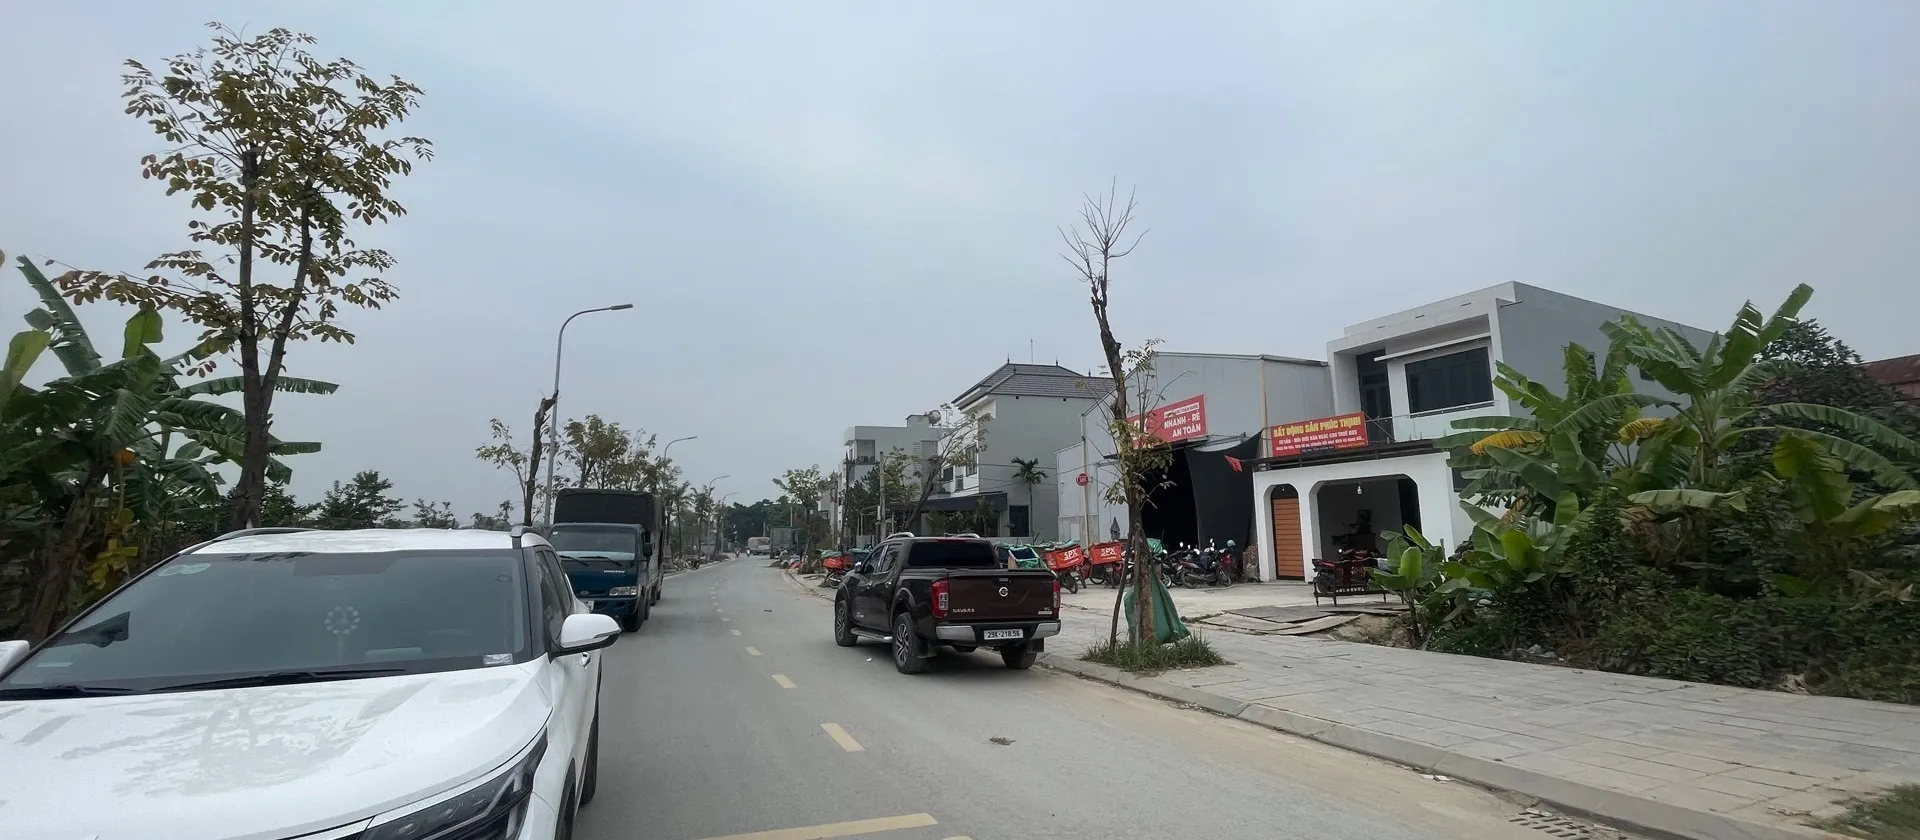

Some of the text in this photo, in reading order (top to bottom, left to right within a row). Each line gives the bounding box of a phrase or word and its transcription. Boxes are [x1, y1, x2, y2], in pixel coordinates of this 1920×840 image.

[1164, 415, 1186, 429] NHANH
[1320, 419, 1338, 430] PHÚC
[1172, 423, 1200, 438] AN TOÀN
[1064, 549, 1078, 560] SPX
[1101, 548, 1115, 556] SPX
